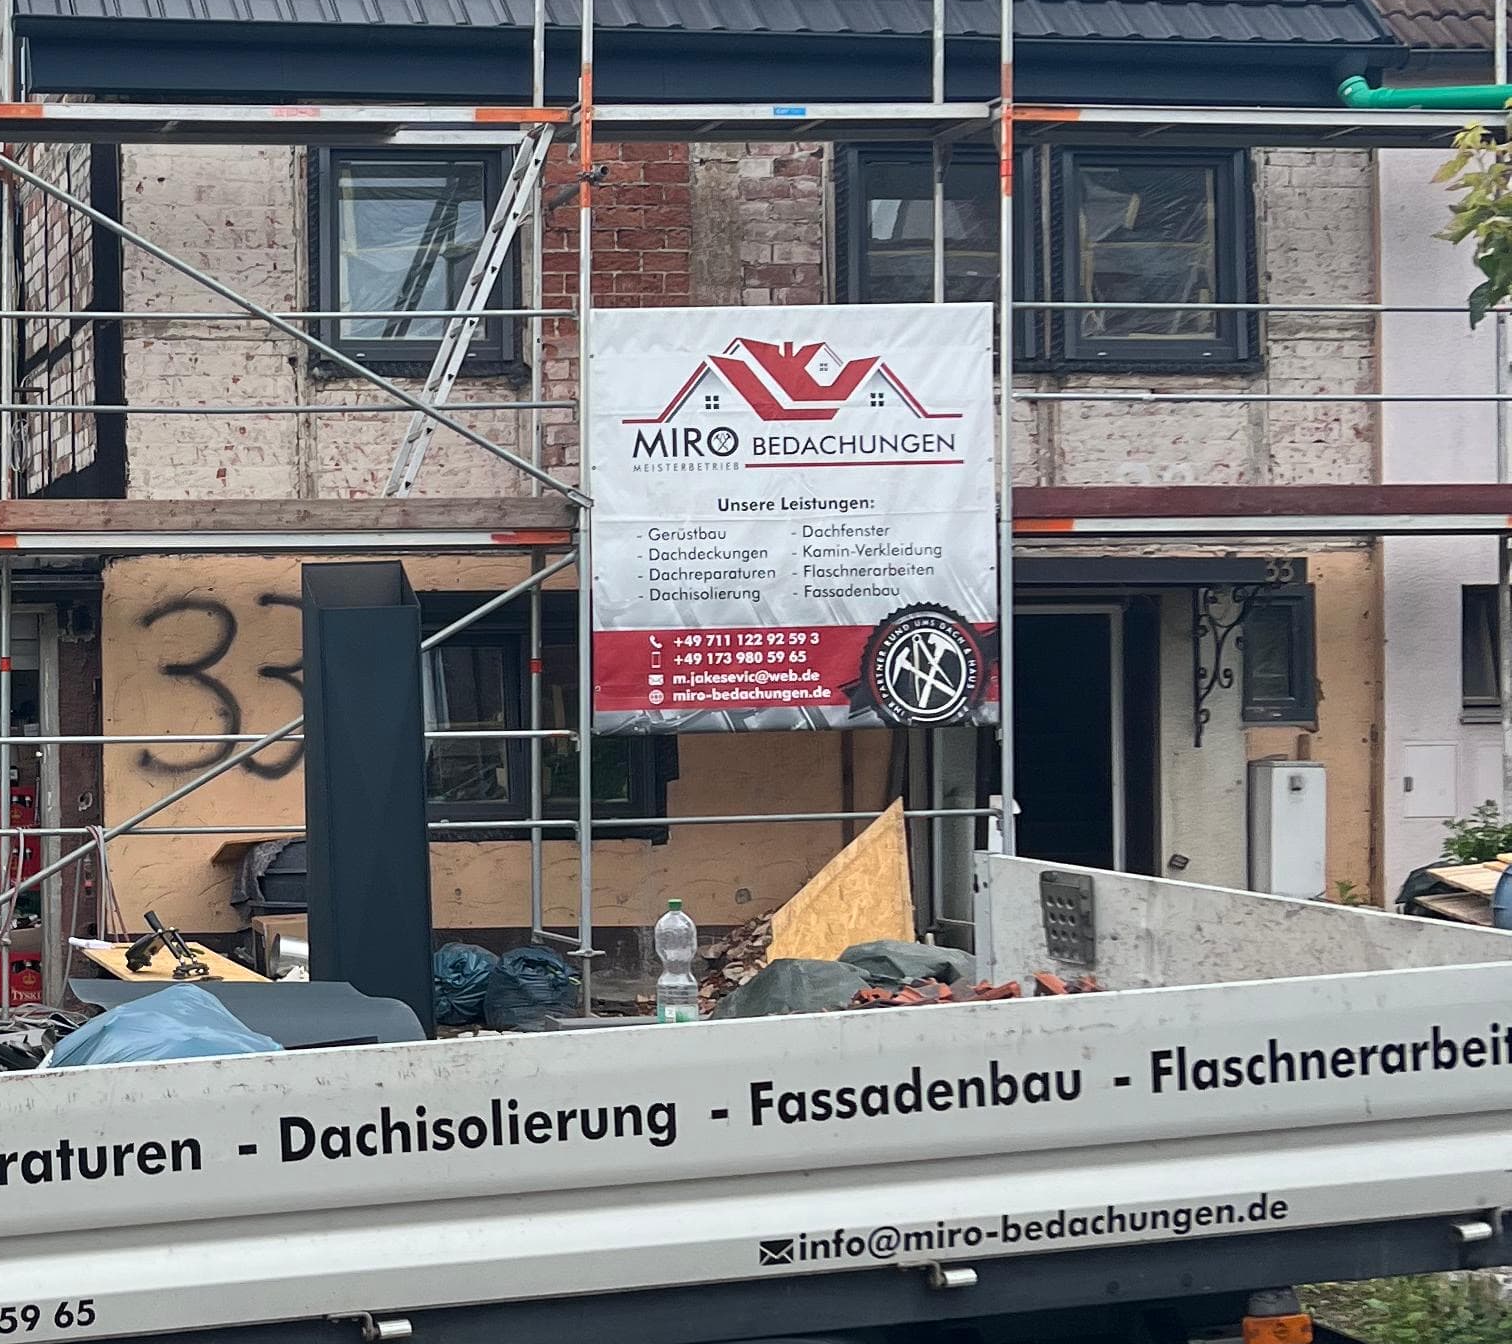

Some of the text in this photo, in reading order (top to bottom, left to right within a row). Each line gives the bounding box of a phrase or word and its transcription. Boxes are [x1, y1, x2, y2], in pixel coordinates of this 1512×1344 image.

[632, 426, 955, 458] MIRO BEDACHUNGEN
[632, 462, 739, 473] MEISTERBETRIEB
[718, 497, 875, 512] Unsere Leistungen:
[648, 527, 726, 541] Gerüstbau
[802, 524, 891, 537] Dachfenster
[649, 546, 768, 562] Dachdeckungen
[803, 542, 942, 558] Kamin-Verkleidung
[649, 567, 776, 583] Dachreparaturen
[804, 563, 934, 577] Flaschnerarbeiten
[650, 587, 760, 602] Dachisolierung
[804, 583, 900, 598] Fassadenbau
[673, 632, 820, 647] +49 711 122 92 59 3
[673, 651, 807, 665] +49 173 980 59 65
[672, 669, 820, 686] m.jakesevic@web.de
[672, 686, 831, 701] miro-bedachungen.de
[280, 1098, 678, 1163] Dachisolierung
[750, 1059, 1083, 1128] Fassadenbau
[796, 1192, 1289, 1263] info@miro-bedachungen.de
[0, 1304, 41, 1334] 59
[53, 1298, 96, 1329] 65
